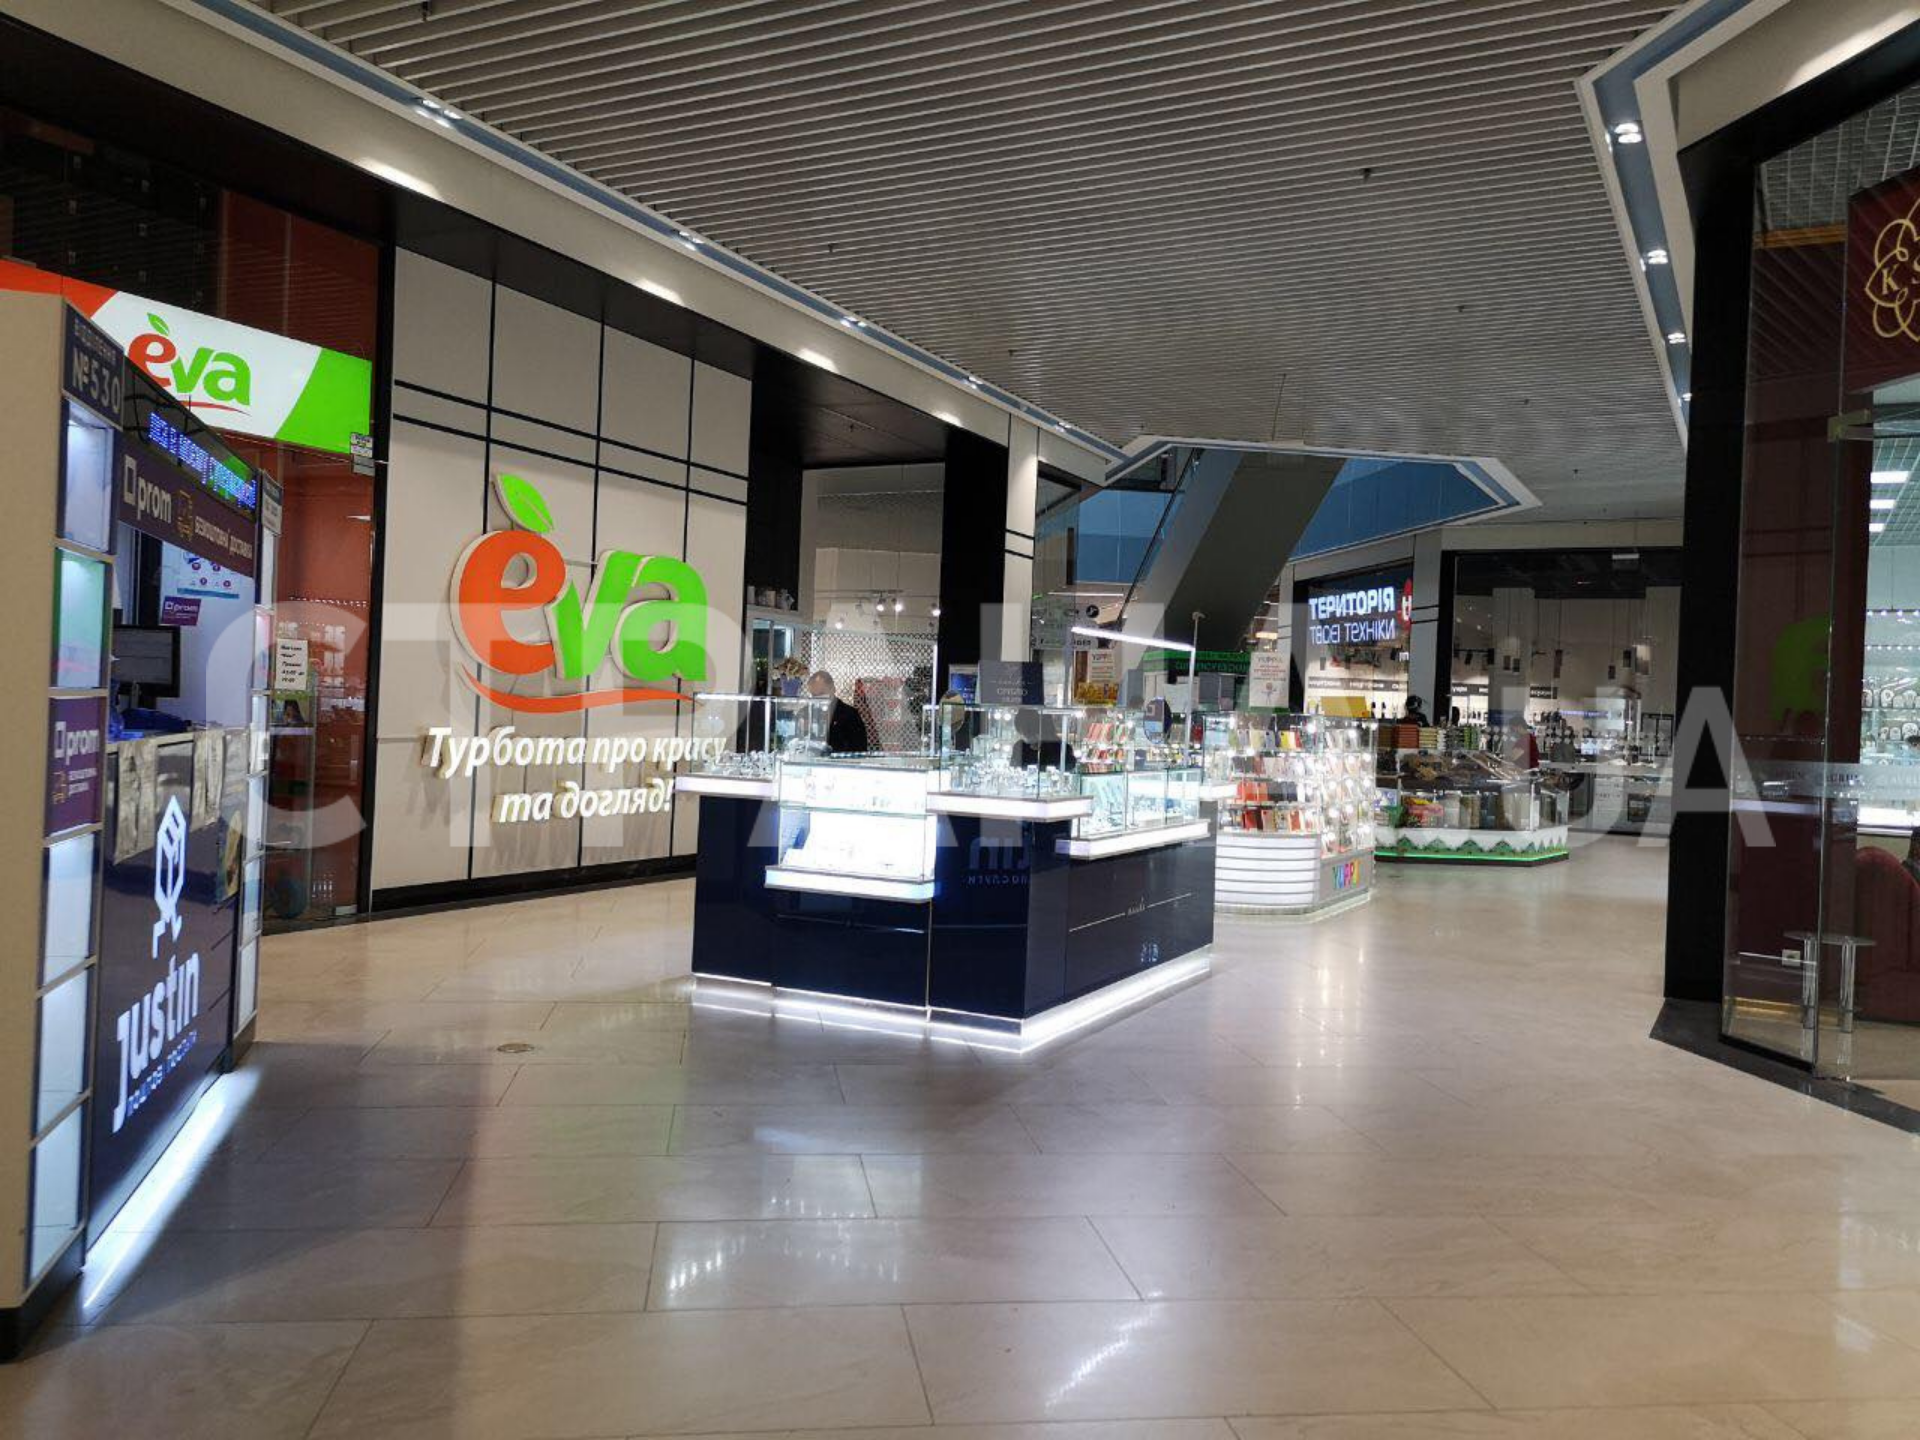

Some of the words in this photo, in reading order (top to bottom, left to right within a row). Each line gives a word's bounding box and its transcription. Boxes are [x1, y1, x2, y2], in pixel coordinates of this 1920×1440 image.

[128, 333, 251, 406] eva
[137, 476, 172, 525] prom
[450, 529, 708, 682] eva
[1308, 586, 1396, 621] ТЕРИТОРІЯ
[65, 729, 100, 766] prom
[427, 726, 587, 779] Турбота
[591, 738, 646, 773] про
[652, 735, 727, 771] красу
[499, 790, 552, 823] та
[560, 780, 672, 819] догляд!
